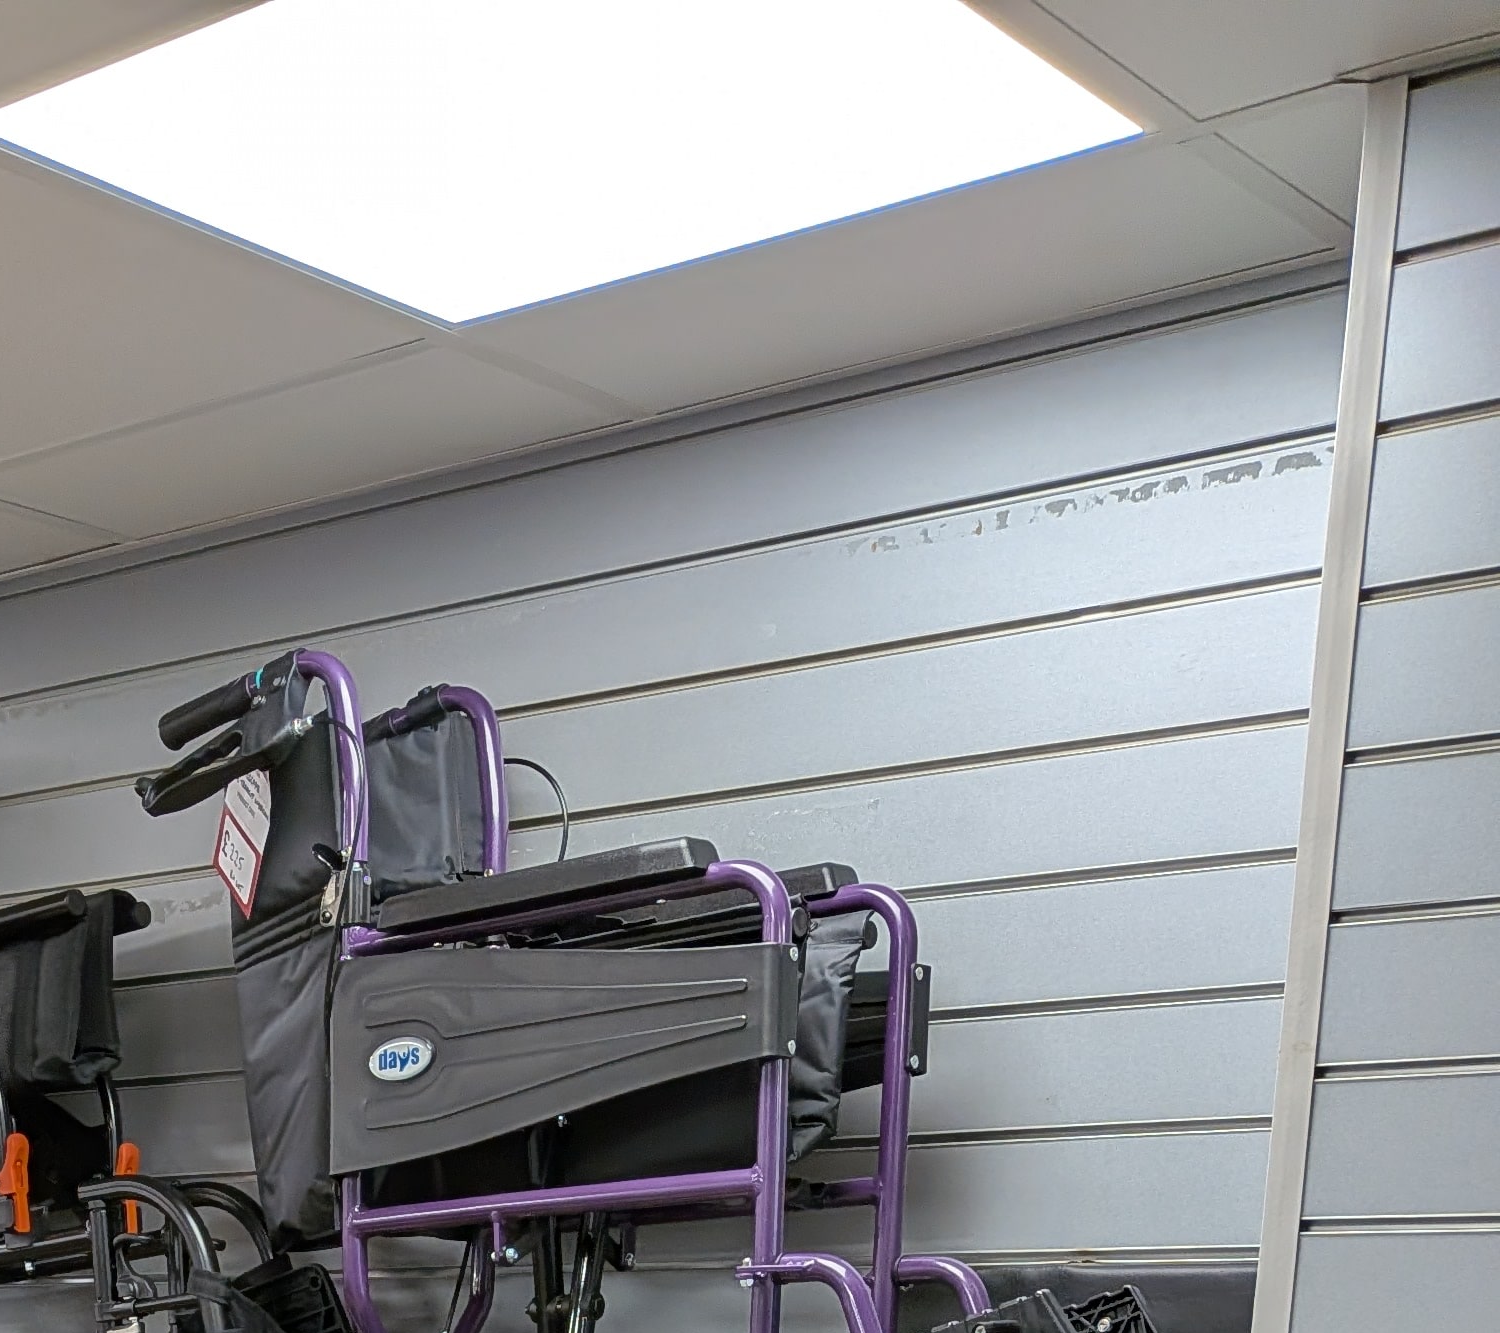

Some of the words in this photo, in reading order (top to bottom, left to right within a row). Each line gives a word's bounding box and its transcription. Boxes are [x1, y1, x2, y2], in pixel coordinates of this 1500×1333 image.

[222, 829, 230, 857] £
[230, 843, 244, 871] 225
[378, 1045, 420, 1073] days
